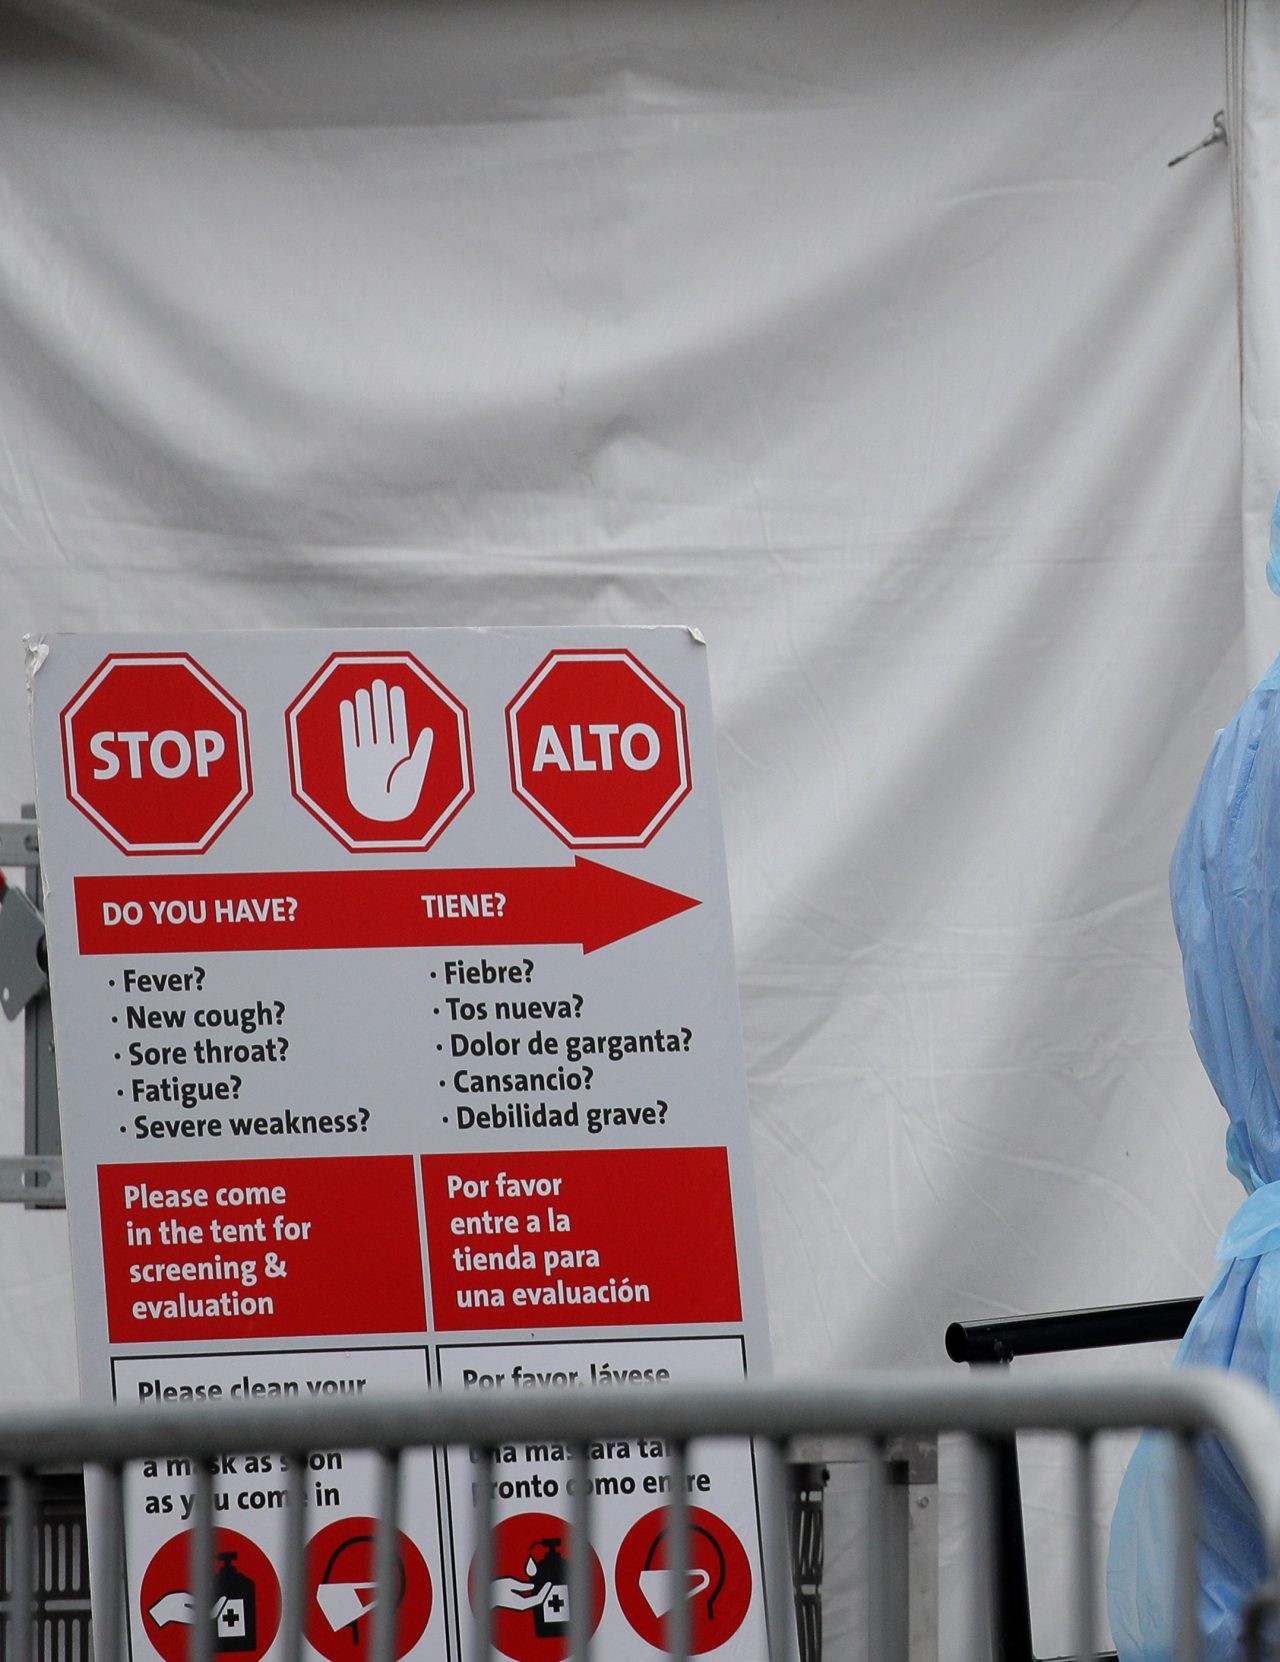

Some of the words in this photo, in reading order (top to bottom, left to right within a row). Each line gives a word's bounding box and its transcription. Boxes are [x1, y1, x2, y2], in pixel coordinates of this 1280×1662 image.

[89, 729, 226, 781] STOP
[531, 722, 661, 774] ALTO
[102, 901, 143, 925] DO
[149, 900, 207, 924] YOU
[214, 896, 298, 923] HAVE?
[421, 892, 507, 918] TIENE?
[123, 965, 206, 993] Fever?
[444, 958, 535, 985] Fiebre?
[126, 1005, 186, 1029] New
[193, 1000, 286, 1034] cough?
[445, 997, 488, 1021] Tos
[495, 993, 584, 1020] nueva?
[128, 1041, 187, 1066] Sore
[193, 1036, 289, 1064] throat?
[450, 1031, 520, 1057] Dolor
[527, 1030, 558, 1055] de
[566, 1026, 693, 1062] garganta?
[131, 1074, 242, 1109] Fatigue?
[453, 1065, 594, 1093] Cansancio?
[134, 1115, 222, 1139] Severe
[229, 1107, 371, 1135] weakness?
[456, 1102, 579, 1129] Debilidad
[586, 1099, 669, 1134] grave?
[124, 1183, 209, 1209] Please
[215, 1185, 286, 1206] come
[447, 1174, 490, 1199] Por
[495, 1171, 562, 1197] favor
[126, 1220, 152, 1246] in
[158, 1218, 203, 1245] the
[209, 1217, 267, 1243] tent
[272, 1215, 312, 1241] for
[450, 1210, 520, 1236] entre
[526, 1213, 541, 1233] a
[547, 1206, 571, 1232] la
[129, 1254, 257, 1287] screening
[264, 1251, 287, 1278] &
[452, 1244, 537, 1272] tienda
[543, 1248, 600, 1276] para
[132, 1290, 274, 1320] evaluation
[456, 1287, 505, 1309] una
[512, 1277, 650, 1306] evaluación
[138, 1379, 222, 1403] Please
[230, 1376, 299, 1400] clean
[306, 1377, 366, 1397] your
[463, 1369, 504, 1392] Por
[590, 1363, 670, 1386] lávese
[143, 1459, 158, 1478] a
[167, 1454, 237, 1477] msk
[244, 1455, 273, 1473] as
[280, 1452, 342, 1472] son
[643, 1473, 710, 1493] enre
[145, 1494, 173, 1514] as
[180, 1492, 229, 1520] yu
[237, 1489, 307, 1511] com
[315, 1482, 340, 1506] in
